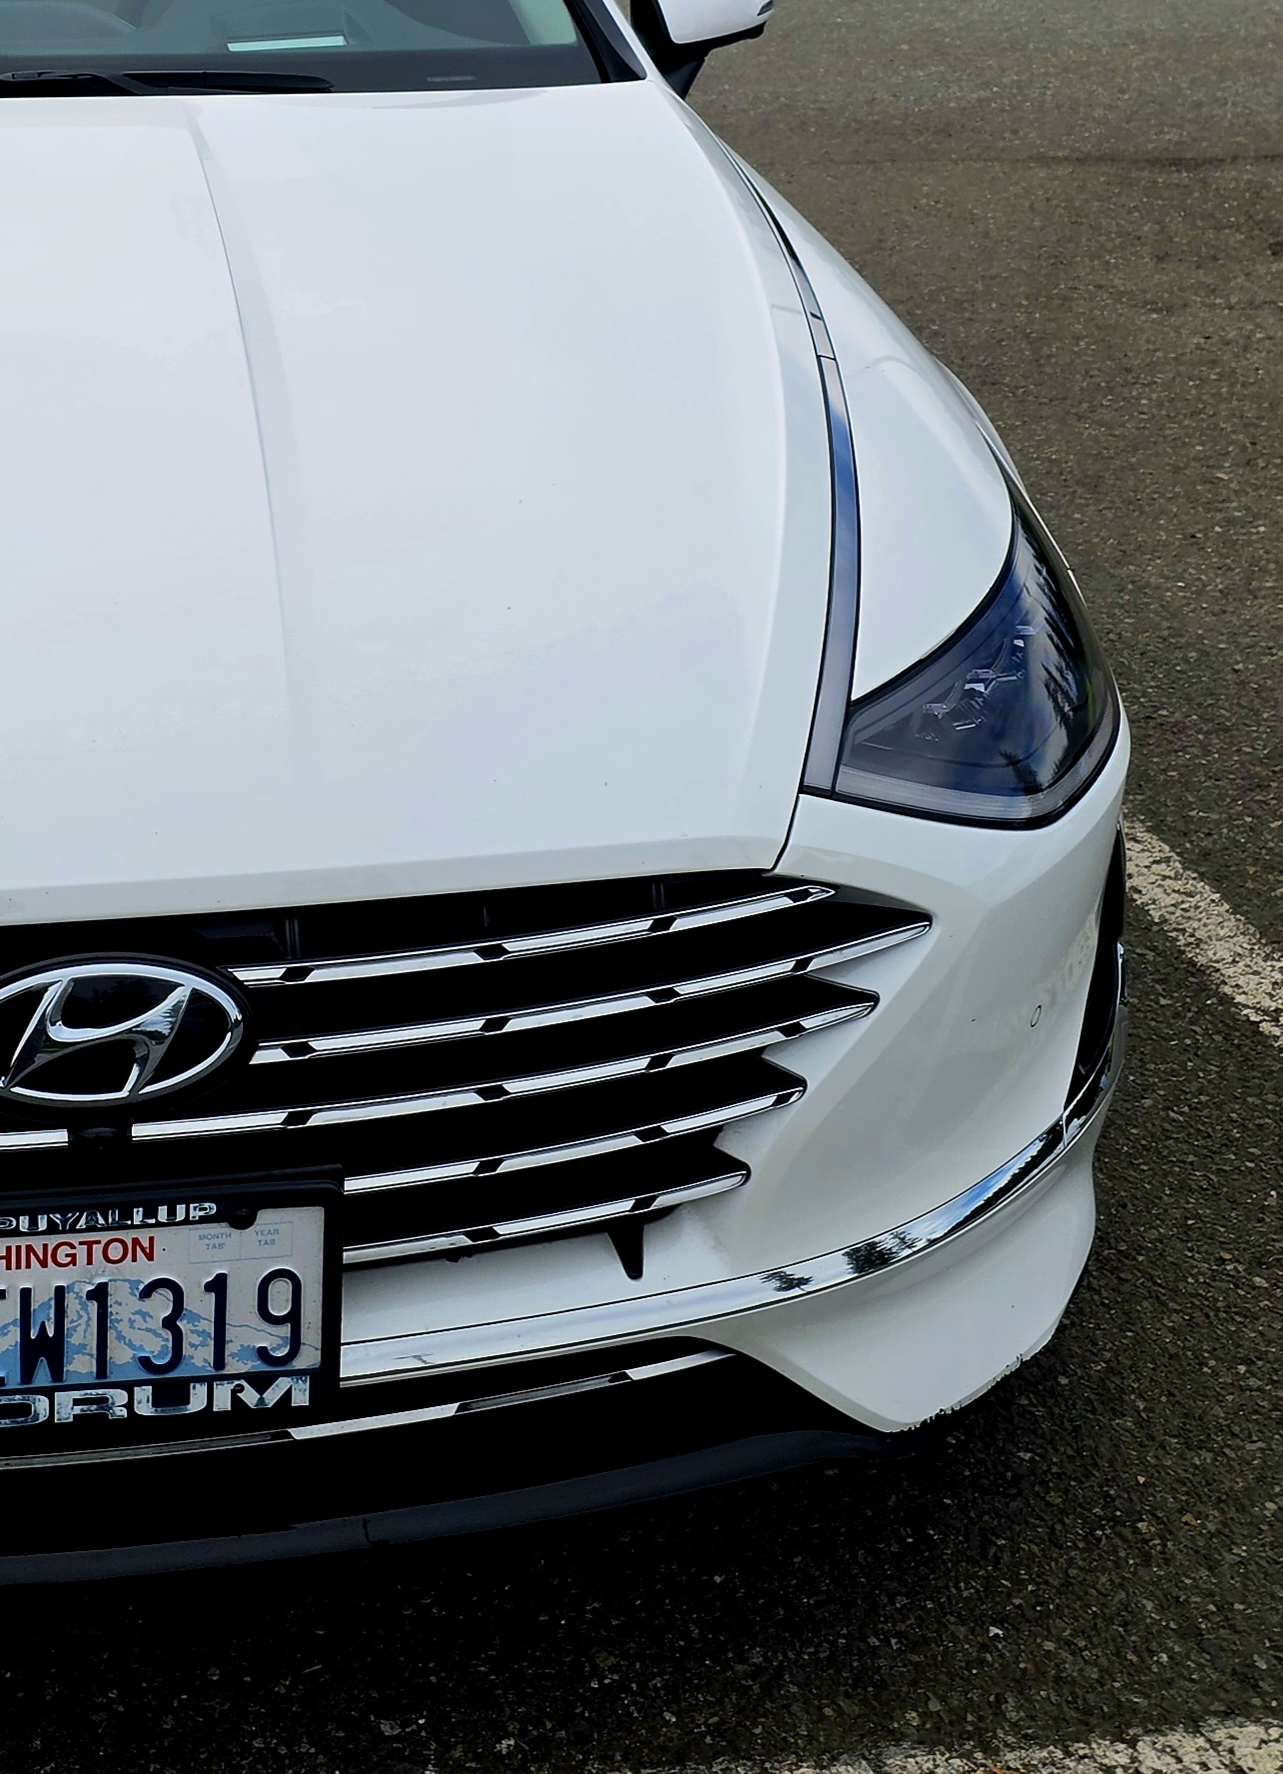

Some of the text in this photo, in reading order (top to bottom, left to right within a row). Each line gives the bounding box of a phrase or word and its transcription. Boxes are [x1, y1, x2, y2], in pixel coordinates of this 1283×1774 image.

[255, 1228, 279, 1236] YEAR
[198, 1232, 232, 1241] MONTH
[258, 1238, 276, 1246] TAB
